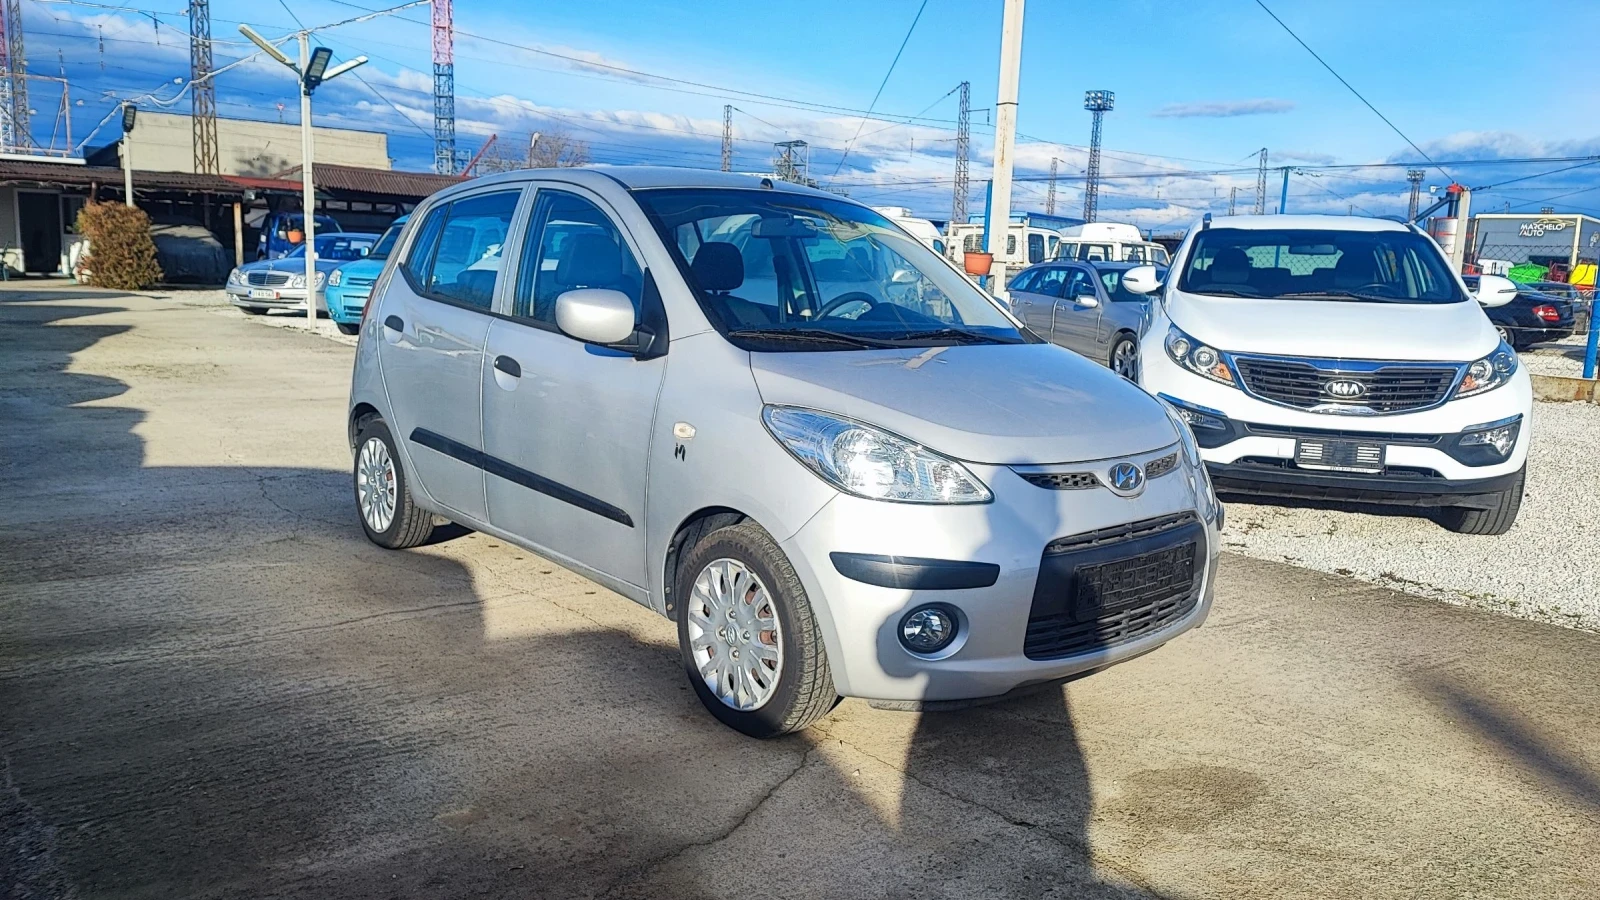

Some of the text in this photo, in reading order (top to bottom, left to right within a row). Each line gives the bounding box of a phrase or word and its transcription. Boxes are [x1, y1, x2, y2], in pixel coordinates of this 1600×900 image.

[1520, 223, 1563, 231] MARCHELO
[1519, 229, 1544, 237] AUTO
[1332, 382, 1360, 395] KIA
